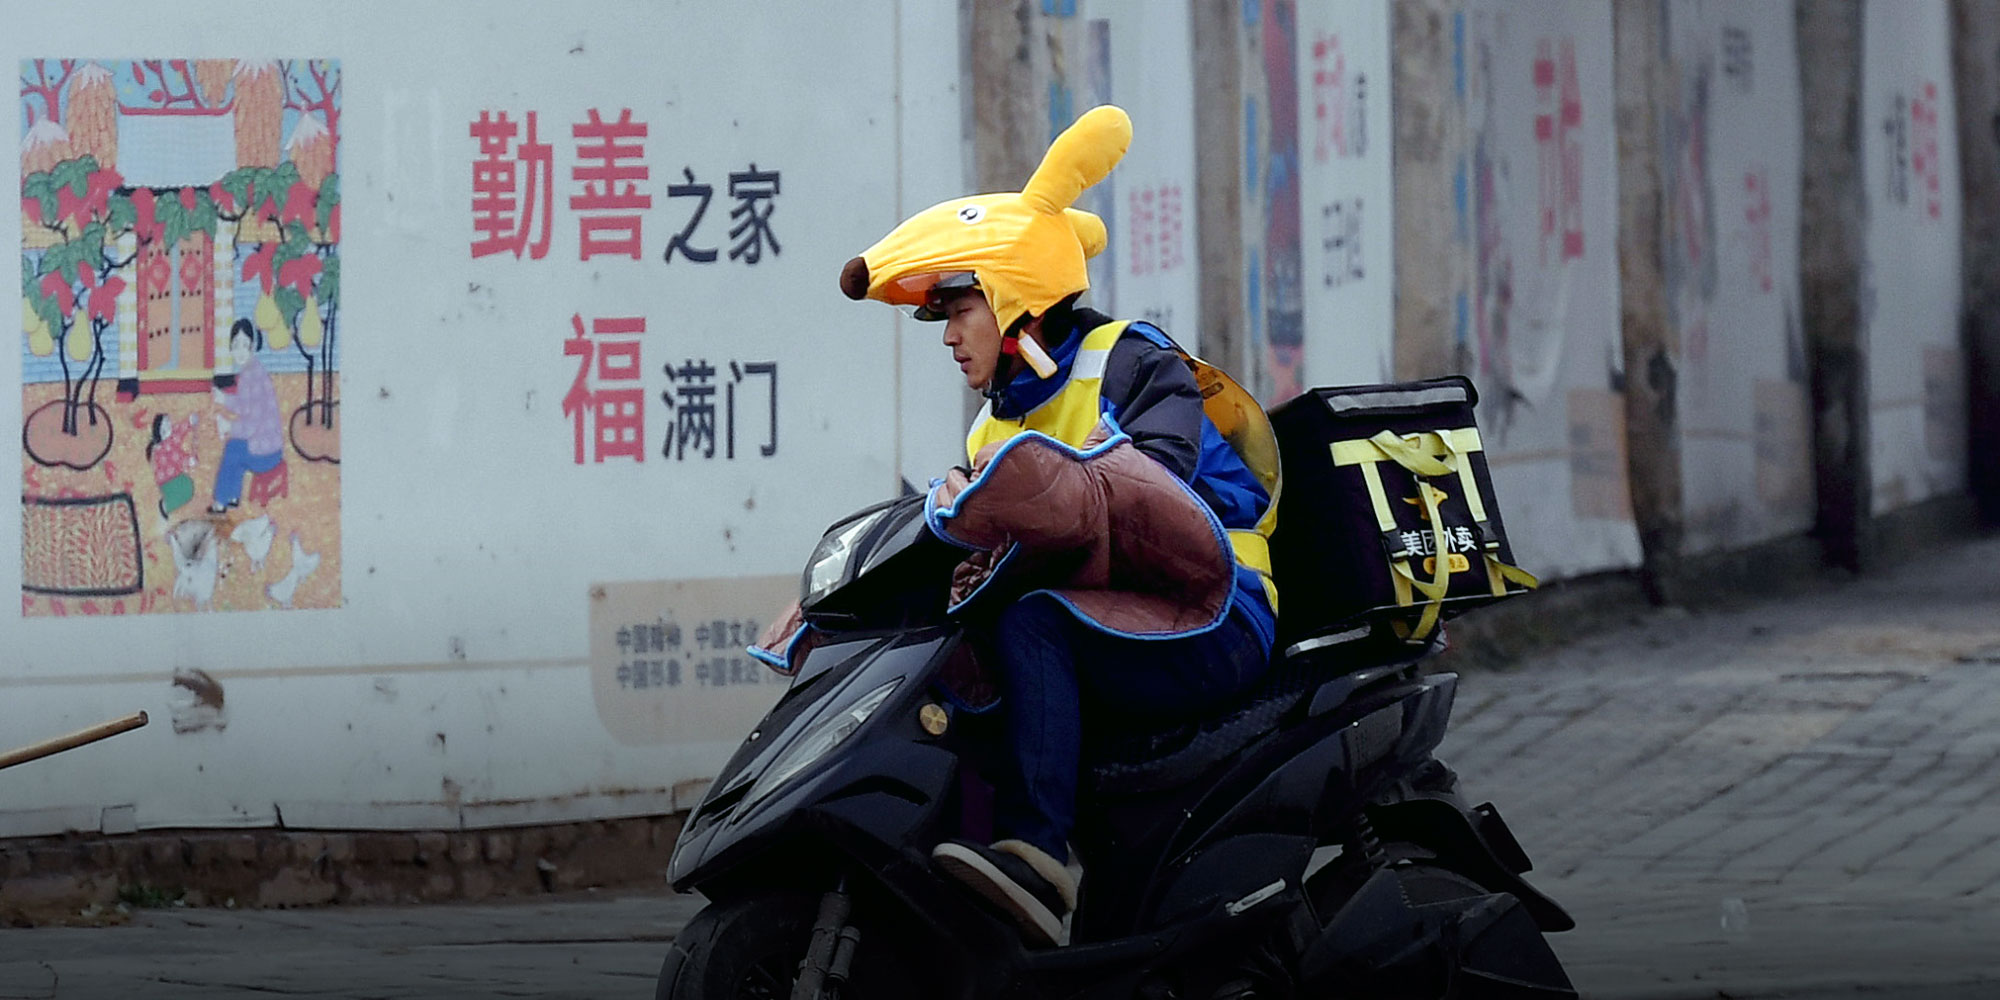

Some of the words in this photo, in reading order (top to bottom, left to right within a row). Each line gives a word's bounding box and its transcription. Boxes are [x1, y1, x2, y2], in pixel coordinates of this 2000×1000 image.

[469, 107, 782, 265] 勤善之家
[561, 312, 778, 465] 福满门
[1400, 526, 1477, 556] 美团外卖
